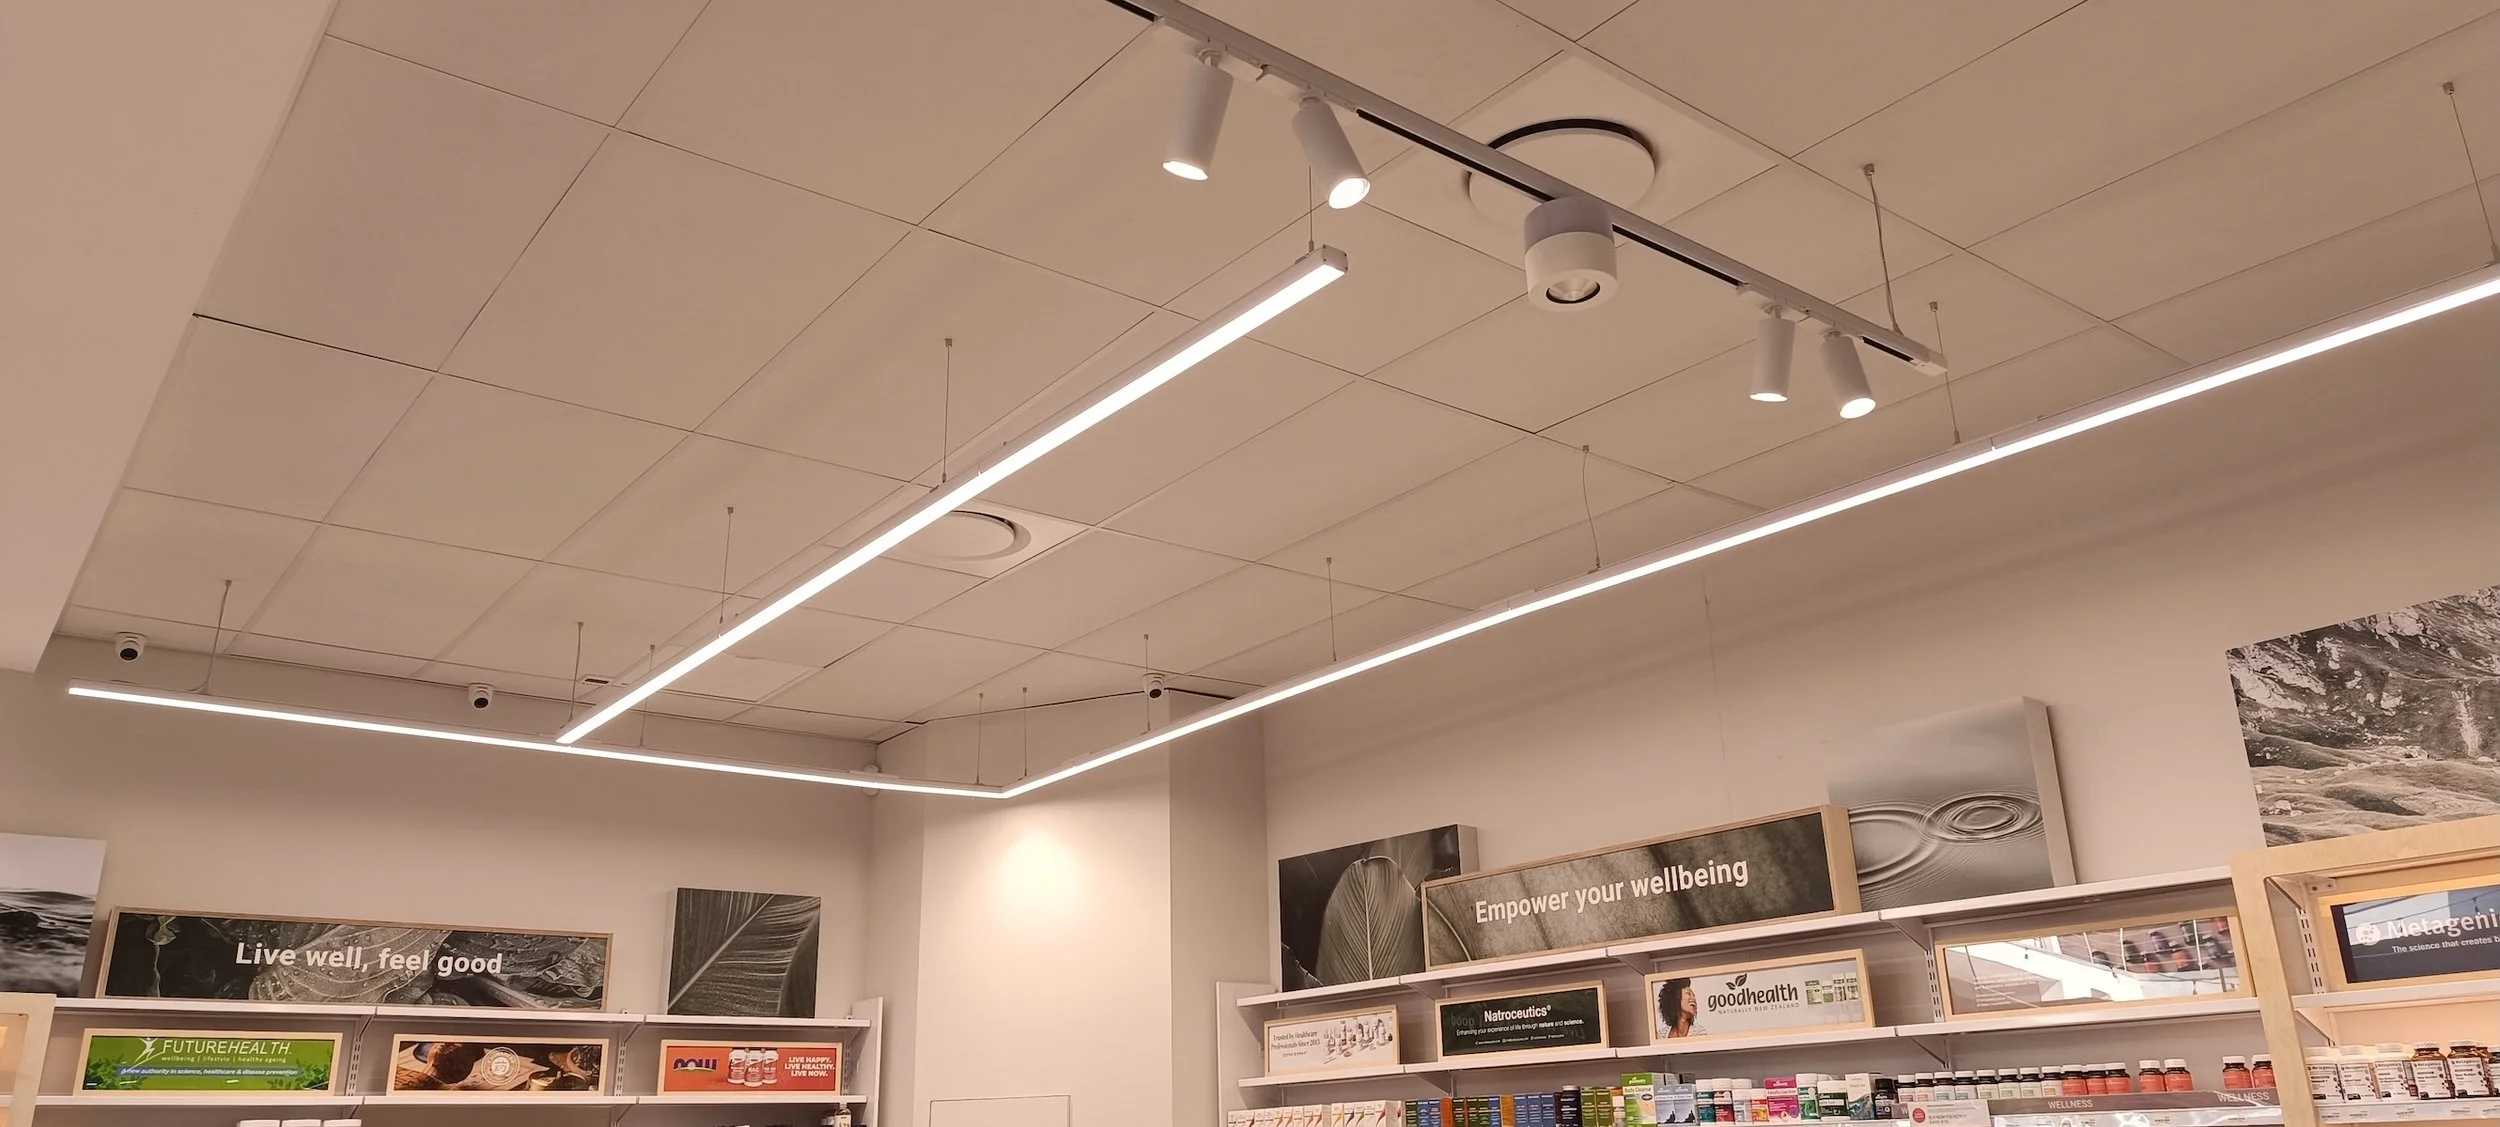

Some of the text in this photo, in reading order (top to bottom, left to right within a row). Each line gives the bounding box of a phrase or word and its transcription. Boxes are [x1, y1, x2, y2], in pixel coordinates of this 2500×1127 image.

[1475, 860, 1749, 925] Empower your wellbeing
[2386, 908, 2500, 939] Metageni
[2409, 942, 2440, 952] science
[2442, 941, 2459, 949] that
[2461, 937, 2493, 946] creates
[235, 942, 503, 977] Live well, feel good
[1708, 984, 1799, 1013] goodhealth
[1718, 1007, 1751, 1015] NATURALLY
[1770, 1002, 1800, 1011] ZEALAND
[1456, 1028, 1478, 1036] Enhancing
[1478, 1027, 1487, 1035] your
[1487, 1026, 1509, 1034] experience
[1522, 1023, 1538, 1031] through
[1563, 1018, 1585, 1026] science.
[163, 1040, 291, 1055] FUTUREHEALTH
[1271, 1041, 1298, 1050] Professionals
[161, 1055, 195, 1063] wellbeing
[202, 1055, 230, 1063] lifestyle
[238, 1056, 262, 1064] healthy
[141, 1068, 169, 1076] authority
[177, 1068, 202, 1076] science,
[203, 1068, 235, 1076] healthcare
[265, 1069, 298, 1077] prevention
[2048, 1099, 2093, 1109] WELLNESS
[2217, 1091, 2270, 1104] WELLNESS
